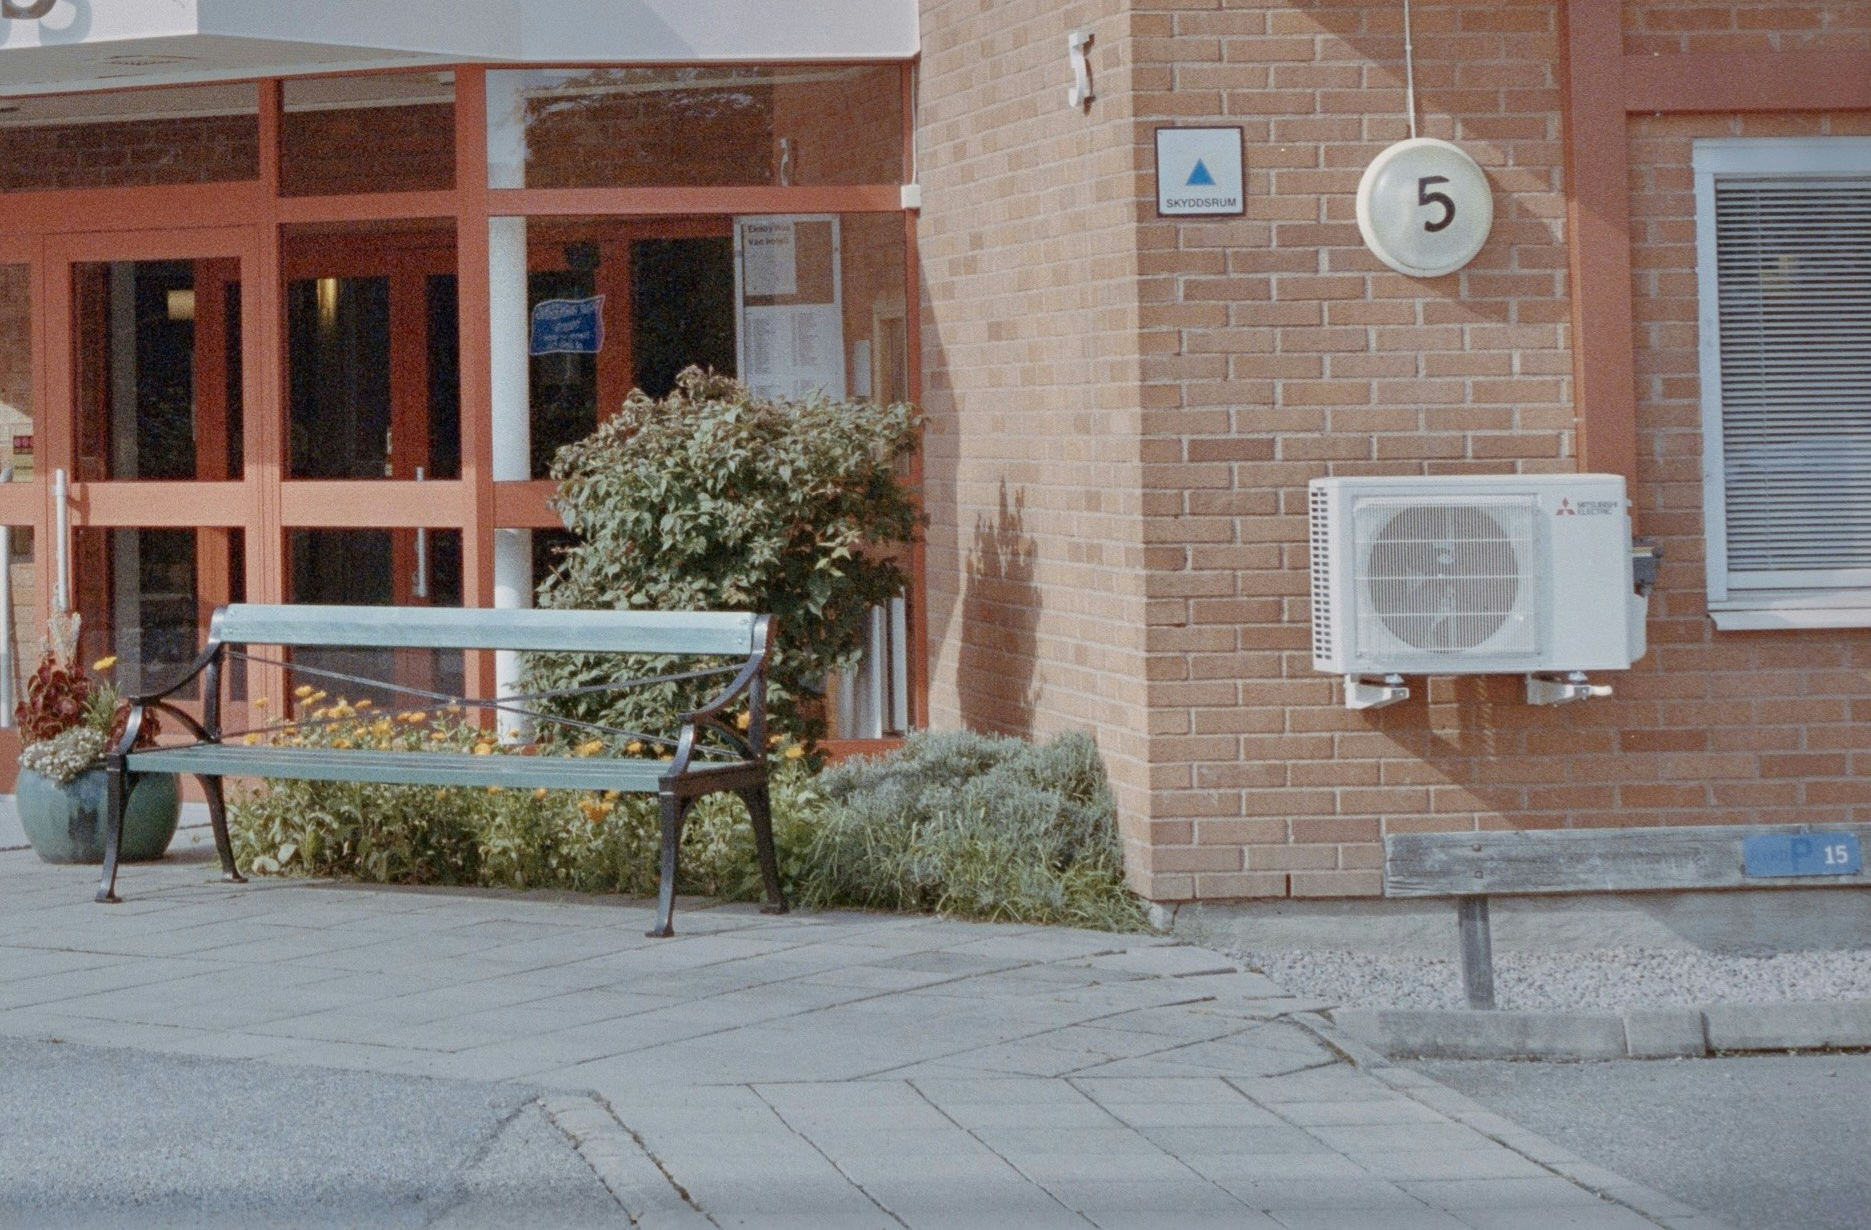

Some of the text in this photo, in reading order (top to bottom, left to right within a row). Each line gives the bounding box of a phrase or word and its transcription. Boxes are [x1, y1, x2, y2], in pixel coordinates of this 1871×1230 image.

[1166, 198, 1237, 208] SKYDDSRUM
[1418, 175, 1456, 233] 5
[1824, 845, 1848, 864] 15
